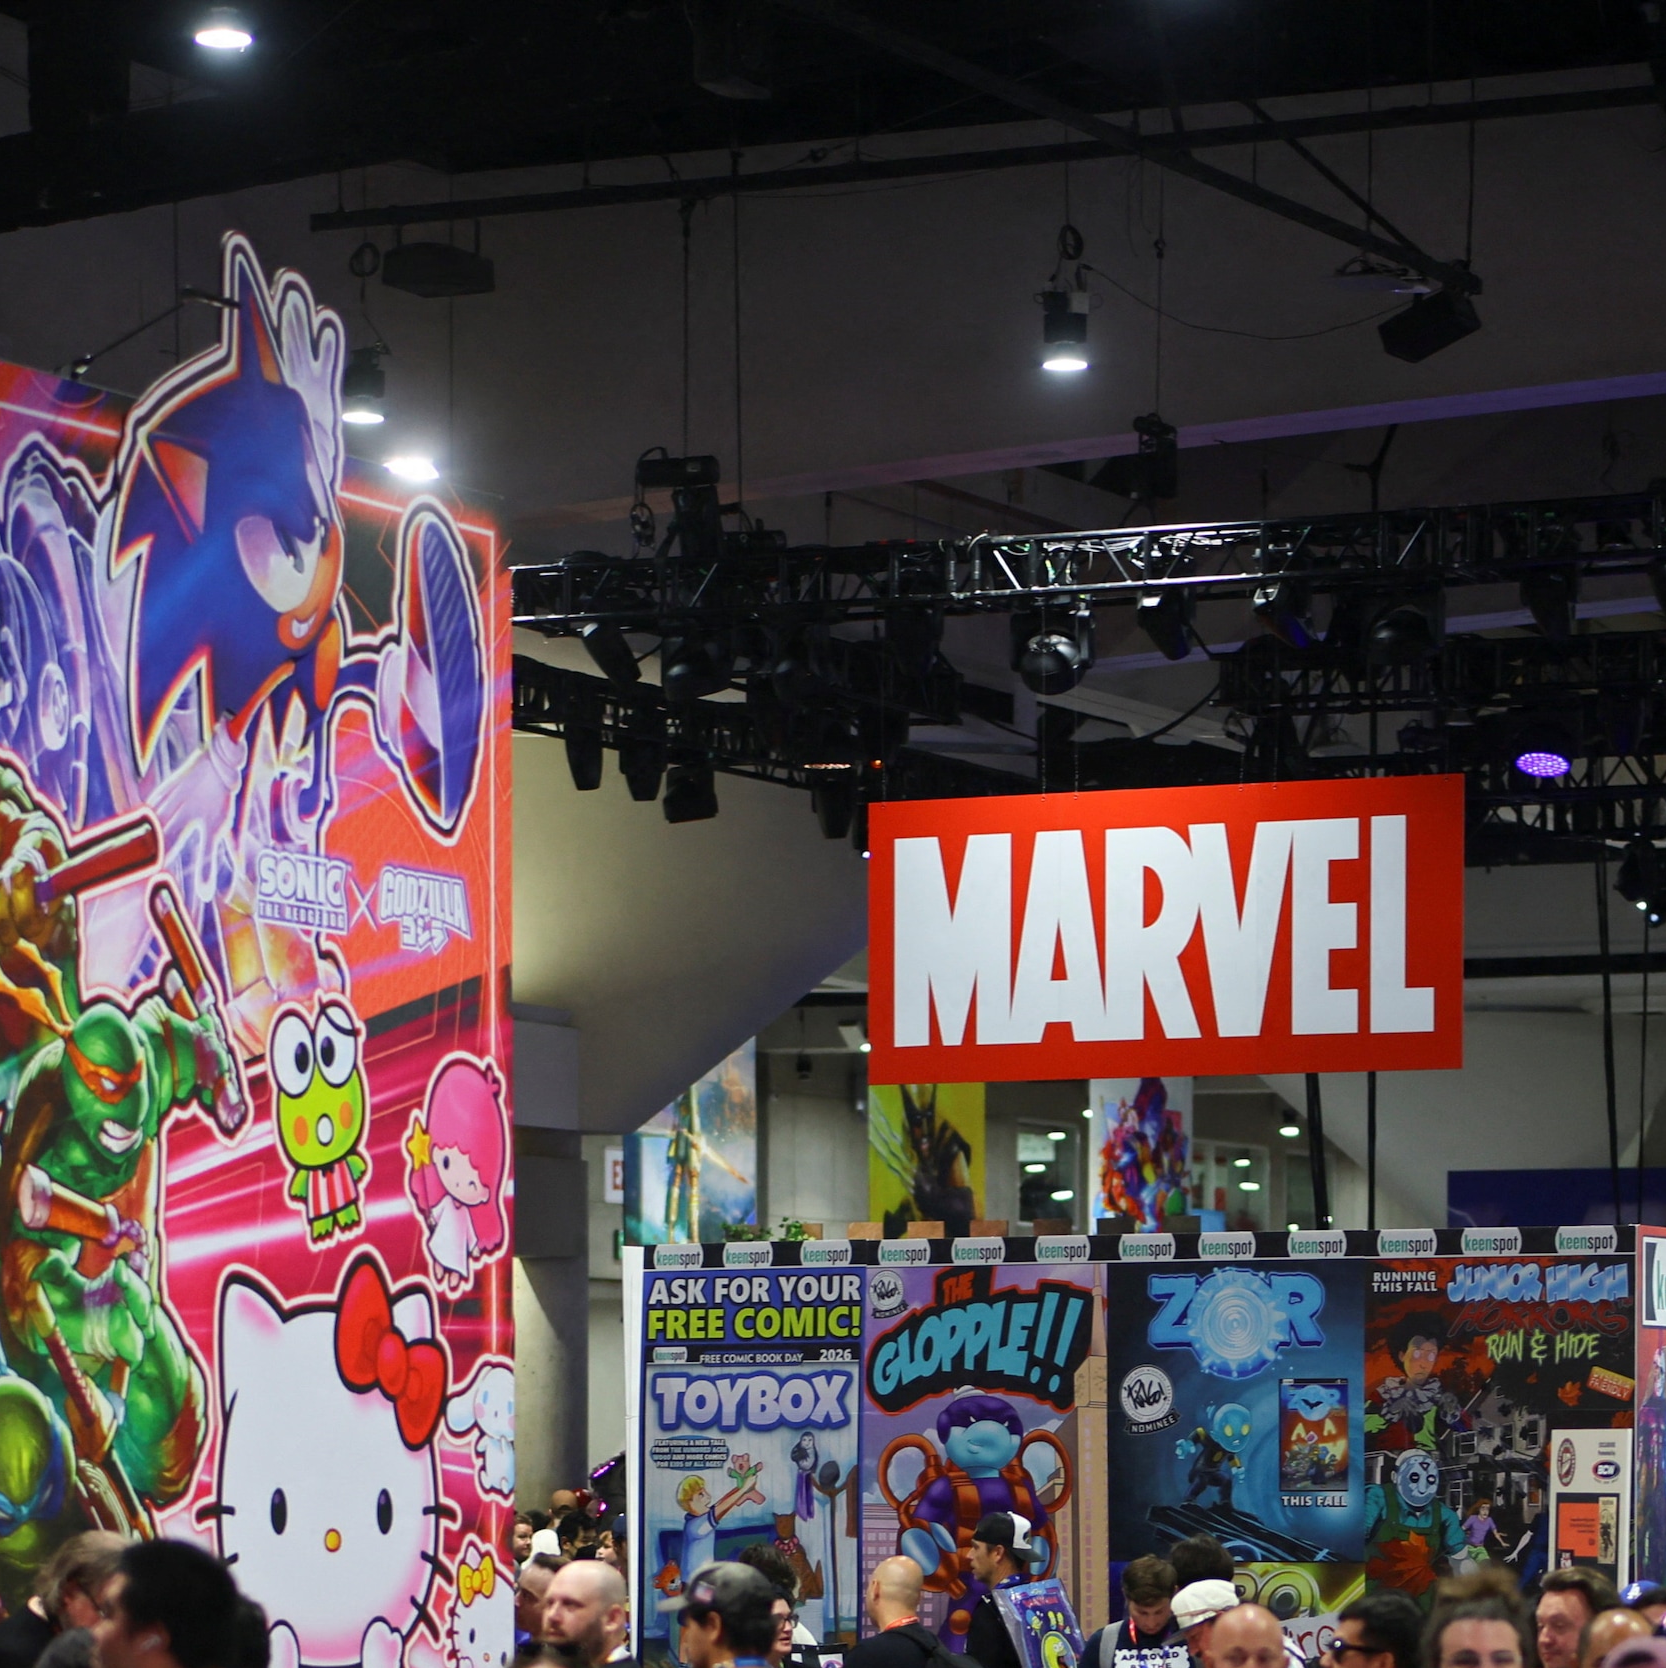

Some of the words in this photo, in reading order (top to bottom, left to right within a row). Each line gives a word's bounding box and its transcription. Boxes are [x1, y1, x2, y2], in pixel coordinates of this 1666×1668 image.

[259, 853, 348, 909] SONIC
[259, 900, 282, 919] THE
[381, 866, 472, 941] GODZILLA
[894, 814, 1435, 1048] MARVEL
[1121, 1240, 1173, 1260] keenspot
[1201, 1238, 1253, 1258] keenspot
[1290, 1237, 1344, 1257] keenspot
[1380, 1235, 1434, 1256] keenspot
[1464, 1233, 1519, 1254] keenspot
[1558, 1231, 1614, 1252] keenspot
[656, 1251, 701, 1269] keenspot
[725, 1249, 771, 1267] keenspot
[803, 1247, 849, 1265] keenspot
[880, 1245, 928, 1265] keenspot
[954, 1244, 1003, 1264] keenspot
[1038, 1242, 1088, 1263] keenspot
[1372, 1271, 1437, 1282] RUNNING
[1372, 1281, 1412, 1293] THIS
[1413, 1281, 1438, 1293] FALL
[1446, 1262, 1542, 1304] JUNIOR
[1545, 1261, 1630, 1302] HIGH
[648, 1277, 707, 1305] ASK
[714, 1276, 770, 1303] FOR
[778, 1274, 861, 1302] YOUR
[942, 1270, 976, 1305] THE
[647, 1308, 725, 1340] FREE
[734, 1305, 862, 1338] COMIC!
[1446, 1299, 1630, 1338] HORRORS
[873, 1291, 1084, 1396] GLOPPLE!!
[1485, 1330, 1524, 1364] RUN
[1531, 1333, 1549, 1367] &
[1555, 1332, 1602, 1364] HIDE
[700, 1354, 722, 1364] FREE
[723, 1353, 754, 1364] COMIC
[756, 1353, 783, 1363] BOOK
[785, 1352, 804, 1363] DAY
[819, 1348, 852, 1361] 2026
[1588, 1377, 1630, 1400] FRIENDLY
[655, 1374, 848, 1427] TOYBOX
[1130, 1414, 1176, 1433] NOMINEE
[1282, 1495, 1313, 1507] THIS
[1316, 1495, 1348, 1507] FALL
